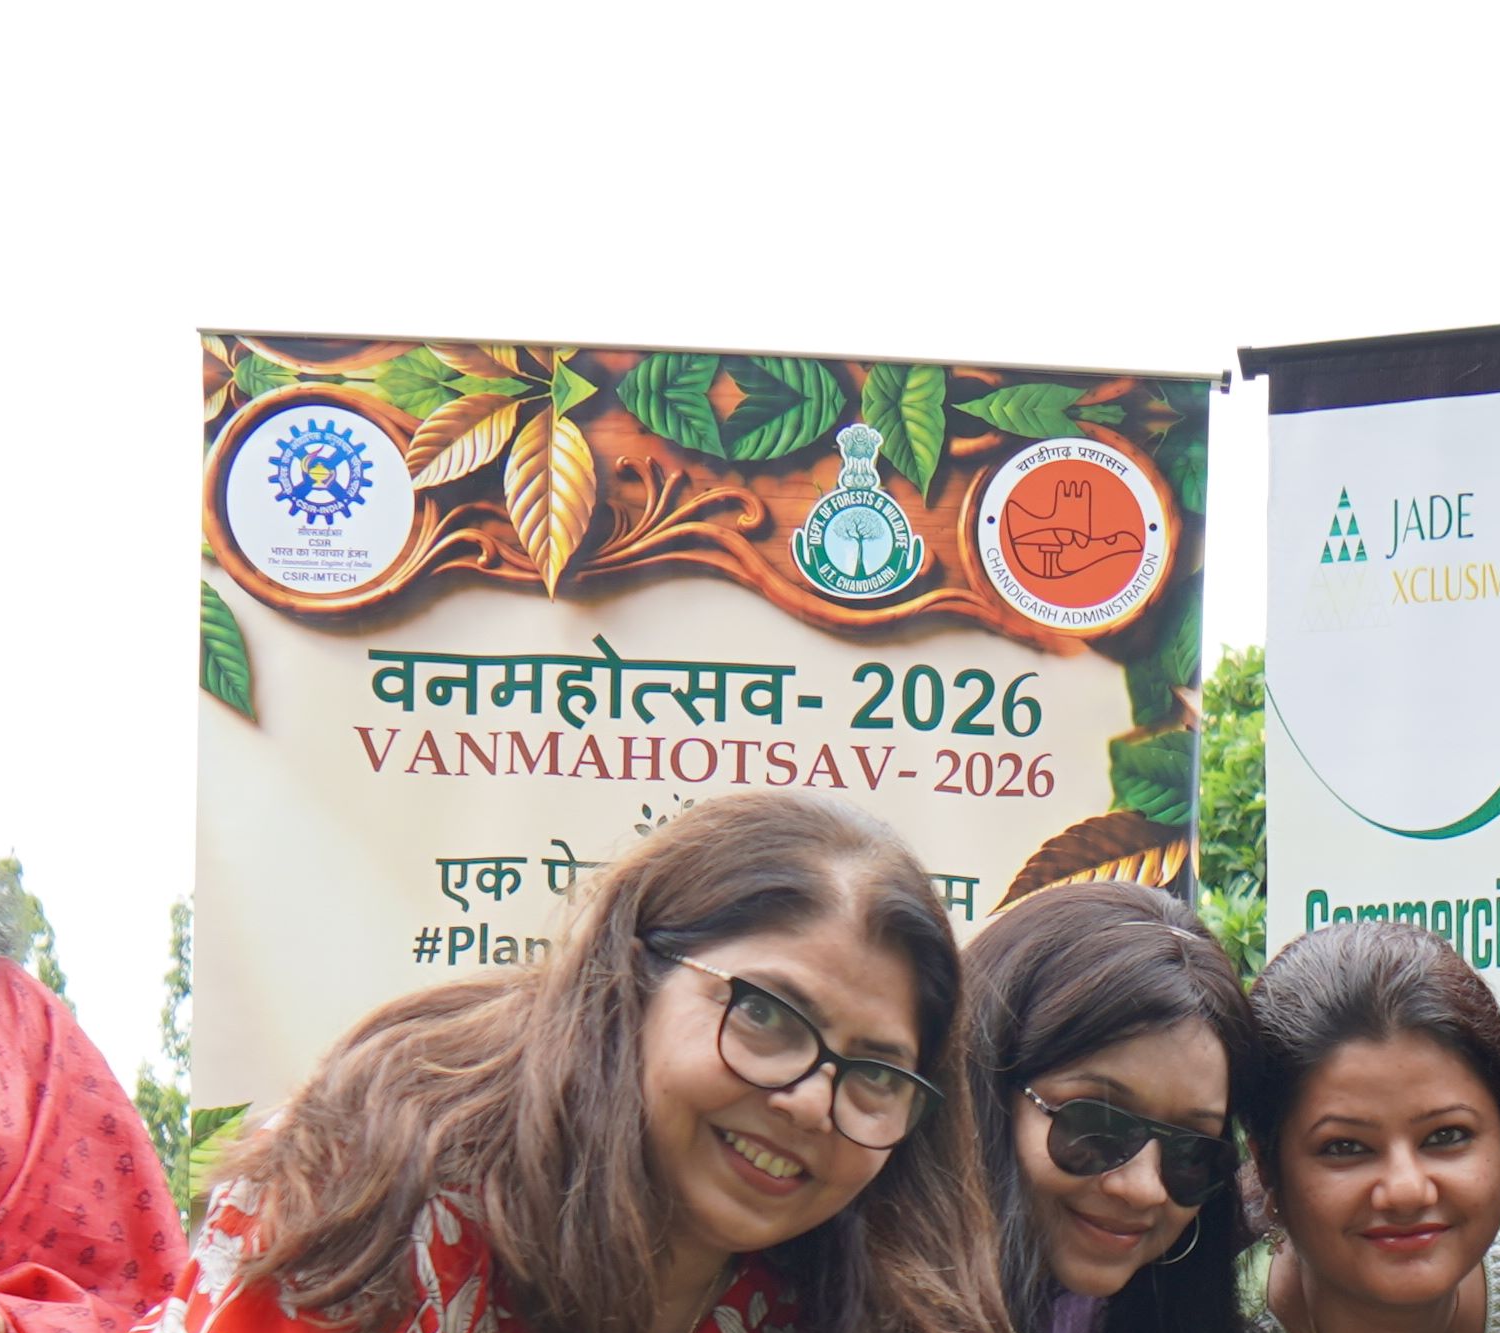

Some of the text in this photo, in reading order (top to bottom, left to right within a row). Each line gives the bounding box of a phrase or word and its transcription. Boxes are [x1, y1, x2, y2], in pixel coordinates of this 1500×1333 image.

[1077, 446, 1128, 477] प्रशासन
[295, 499, 346, 514] CSIR-INDIA
[819, 505, 834, 519] OF
[830, 491, 876, 511] FORESTS
[874, 497, 885, 510] &
[881, 503, 909, 549] WILDLIFE
[308, 538, 331, 547] CSIR
[1385, 493, 1474, 559] JADE
[268, 557, 281, 565] The
[281, 558, 319, 567] Innovation
[320, 560, 344, 569] Engine
[271, 547, 293, 557] भारत
[296, 548, 309, 557] का
[282, 571, 357, 583] CSIR-IMTECH
[819, 563, 896, 593] U.T. CHANDIGARH
[986, 547, 1159, 625] CHANDIGARH ADMINISTRATION
[368, 633, 1042, 737] वनमहोत्सव- 2026
[353, 726, 1055, 798] VANMAHOTSAV- 2026
[435, 856, 527, 913] एक
[541, 839, 592, 904] पे
[413, 923, 553, 966] #Plan
